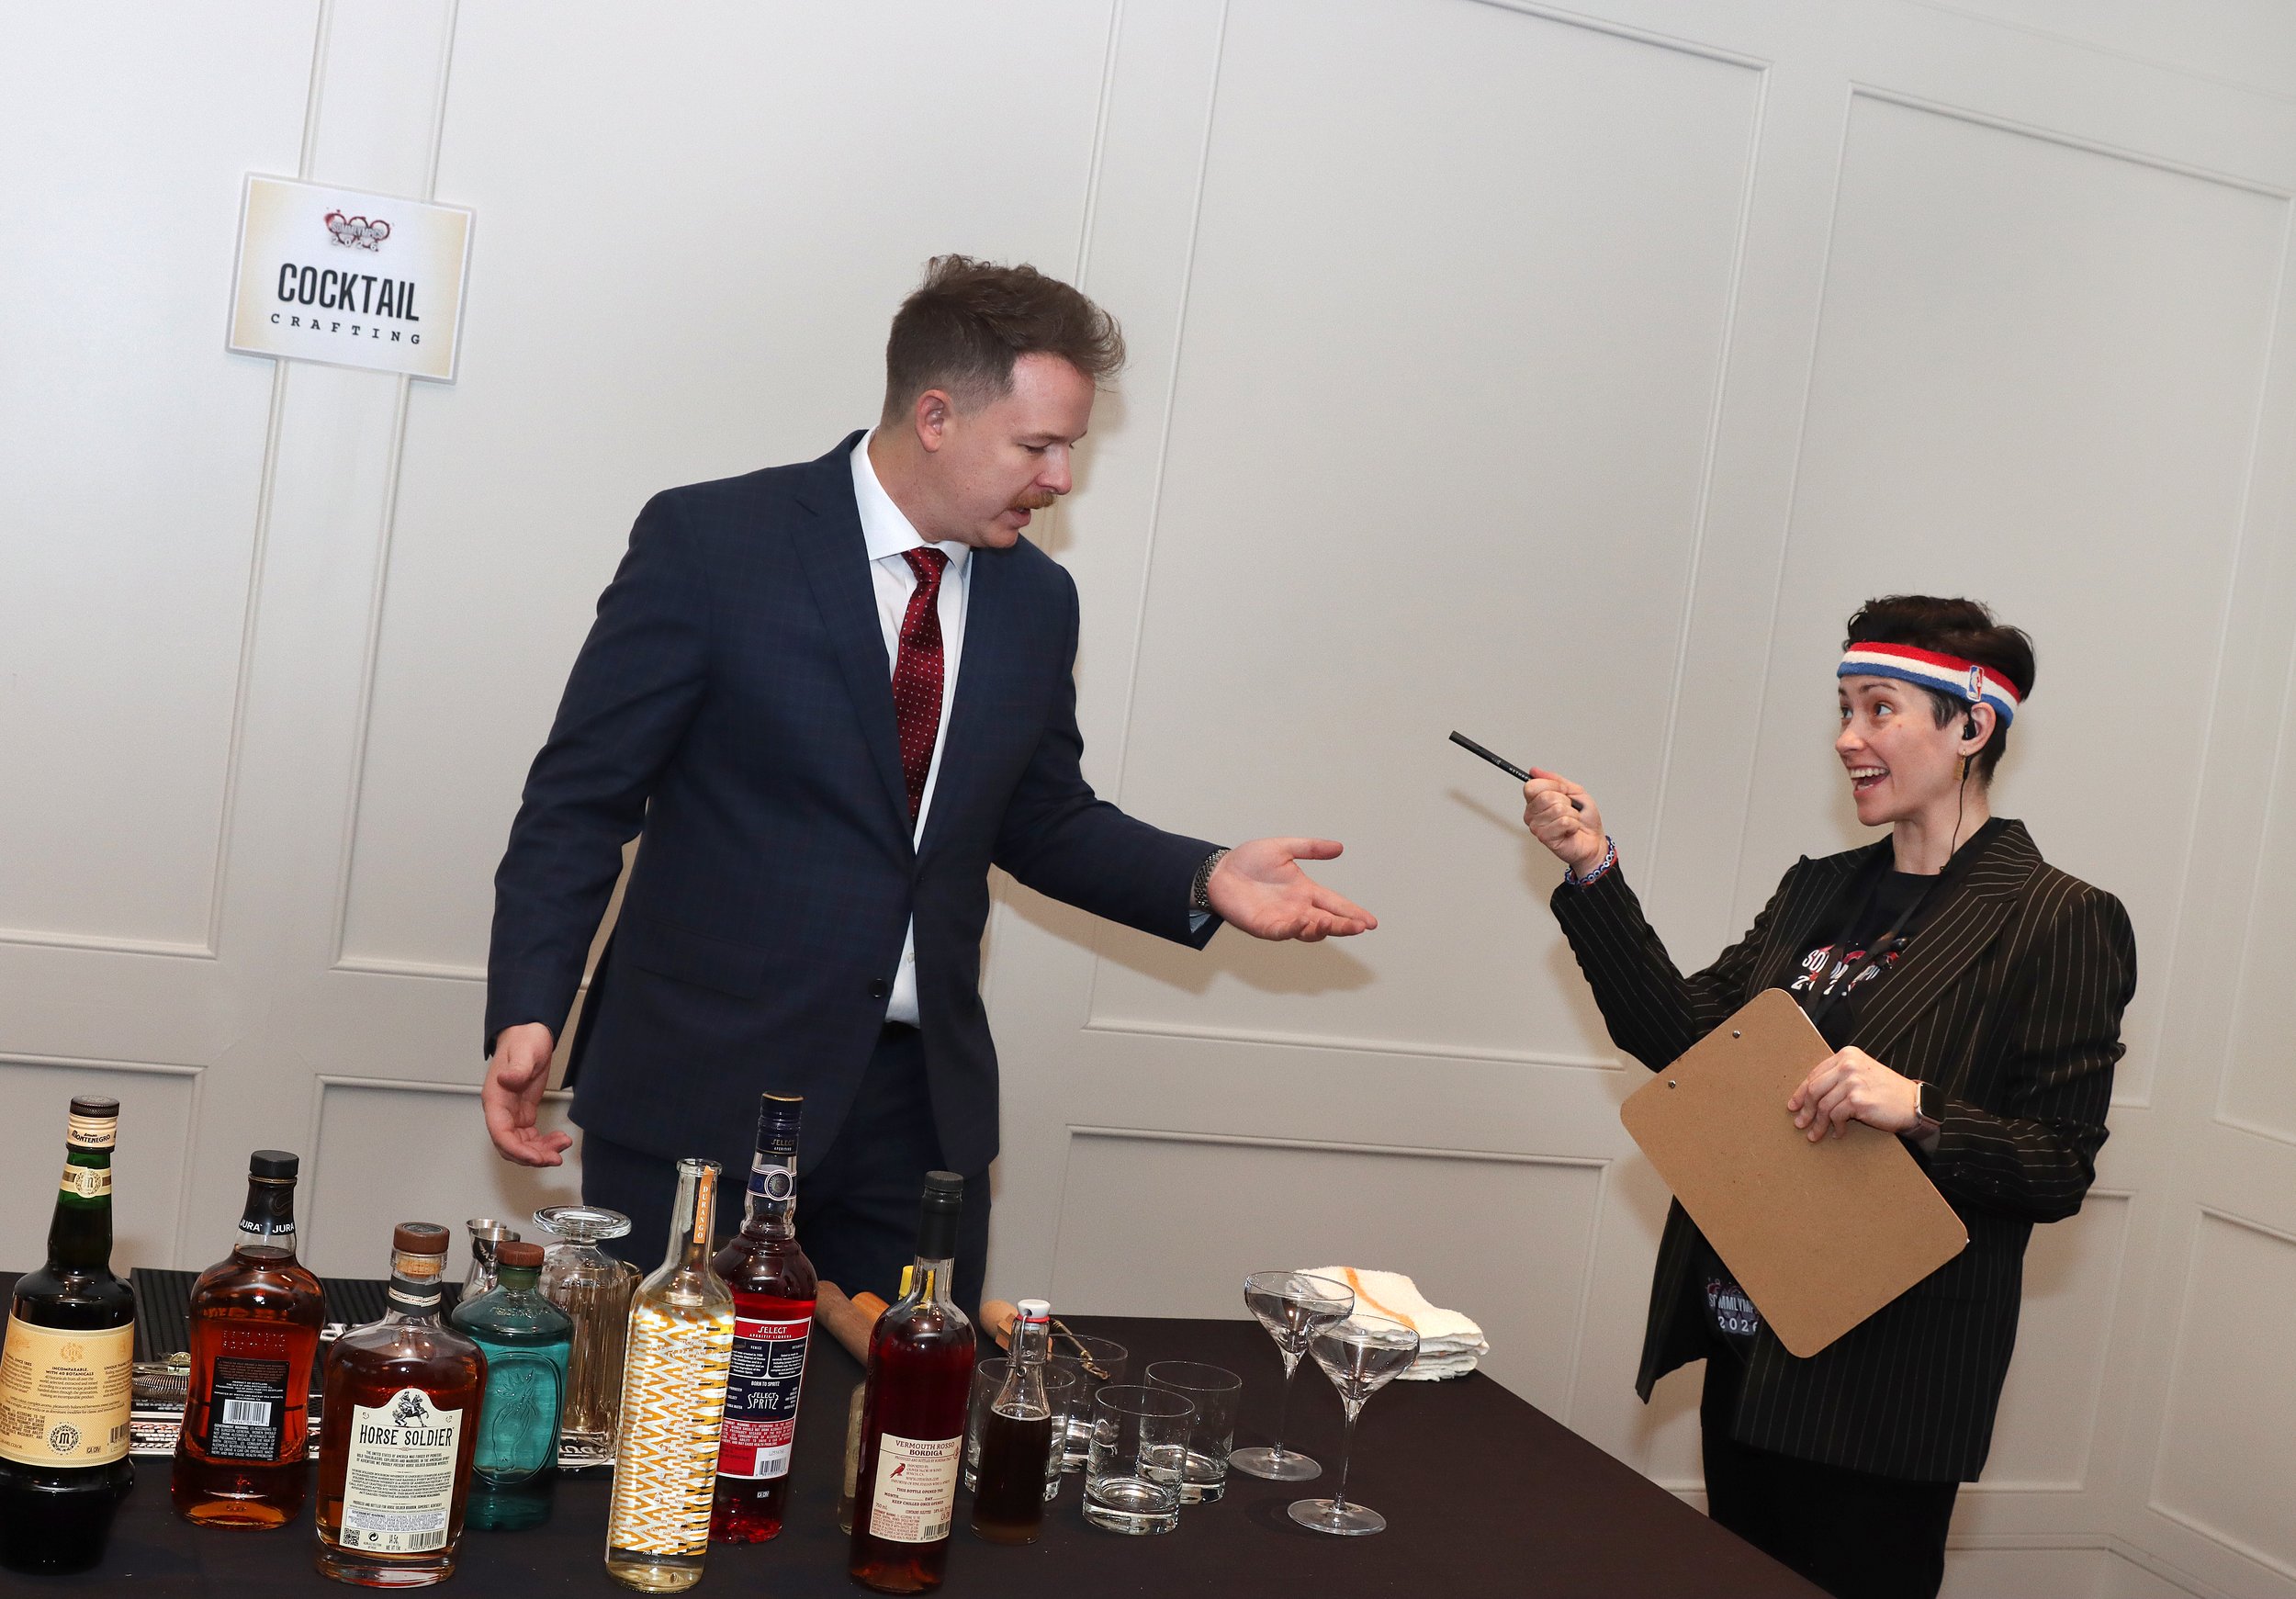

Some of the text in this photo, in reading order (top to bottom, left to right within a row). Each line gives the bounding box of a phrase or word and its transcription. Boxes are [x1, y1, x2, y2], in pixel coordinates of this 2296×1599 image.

[332, 237, 377, 251] 2026
[278, 263, 420, 321] COCKTAIL
[271, 313, 421, 344] CRAFTING
[697, 1186, 709, 1239] DURANGO
[240, 1220, 261, 1232] JURA
[272, 1222, 294, 1233] JURA
[748, 1394, 779, 1410] SPRITZ
[359, 1424, 453, 1447] HORSE SOLDIER
[896, 1440, 935, 1449] VERMOUTH
